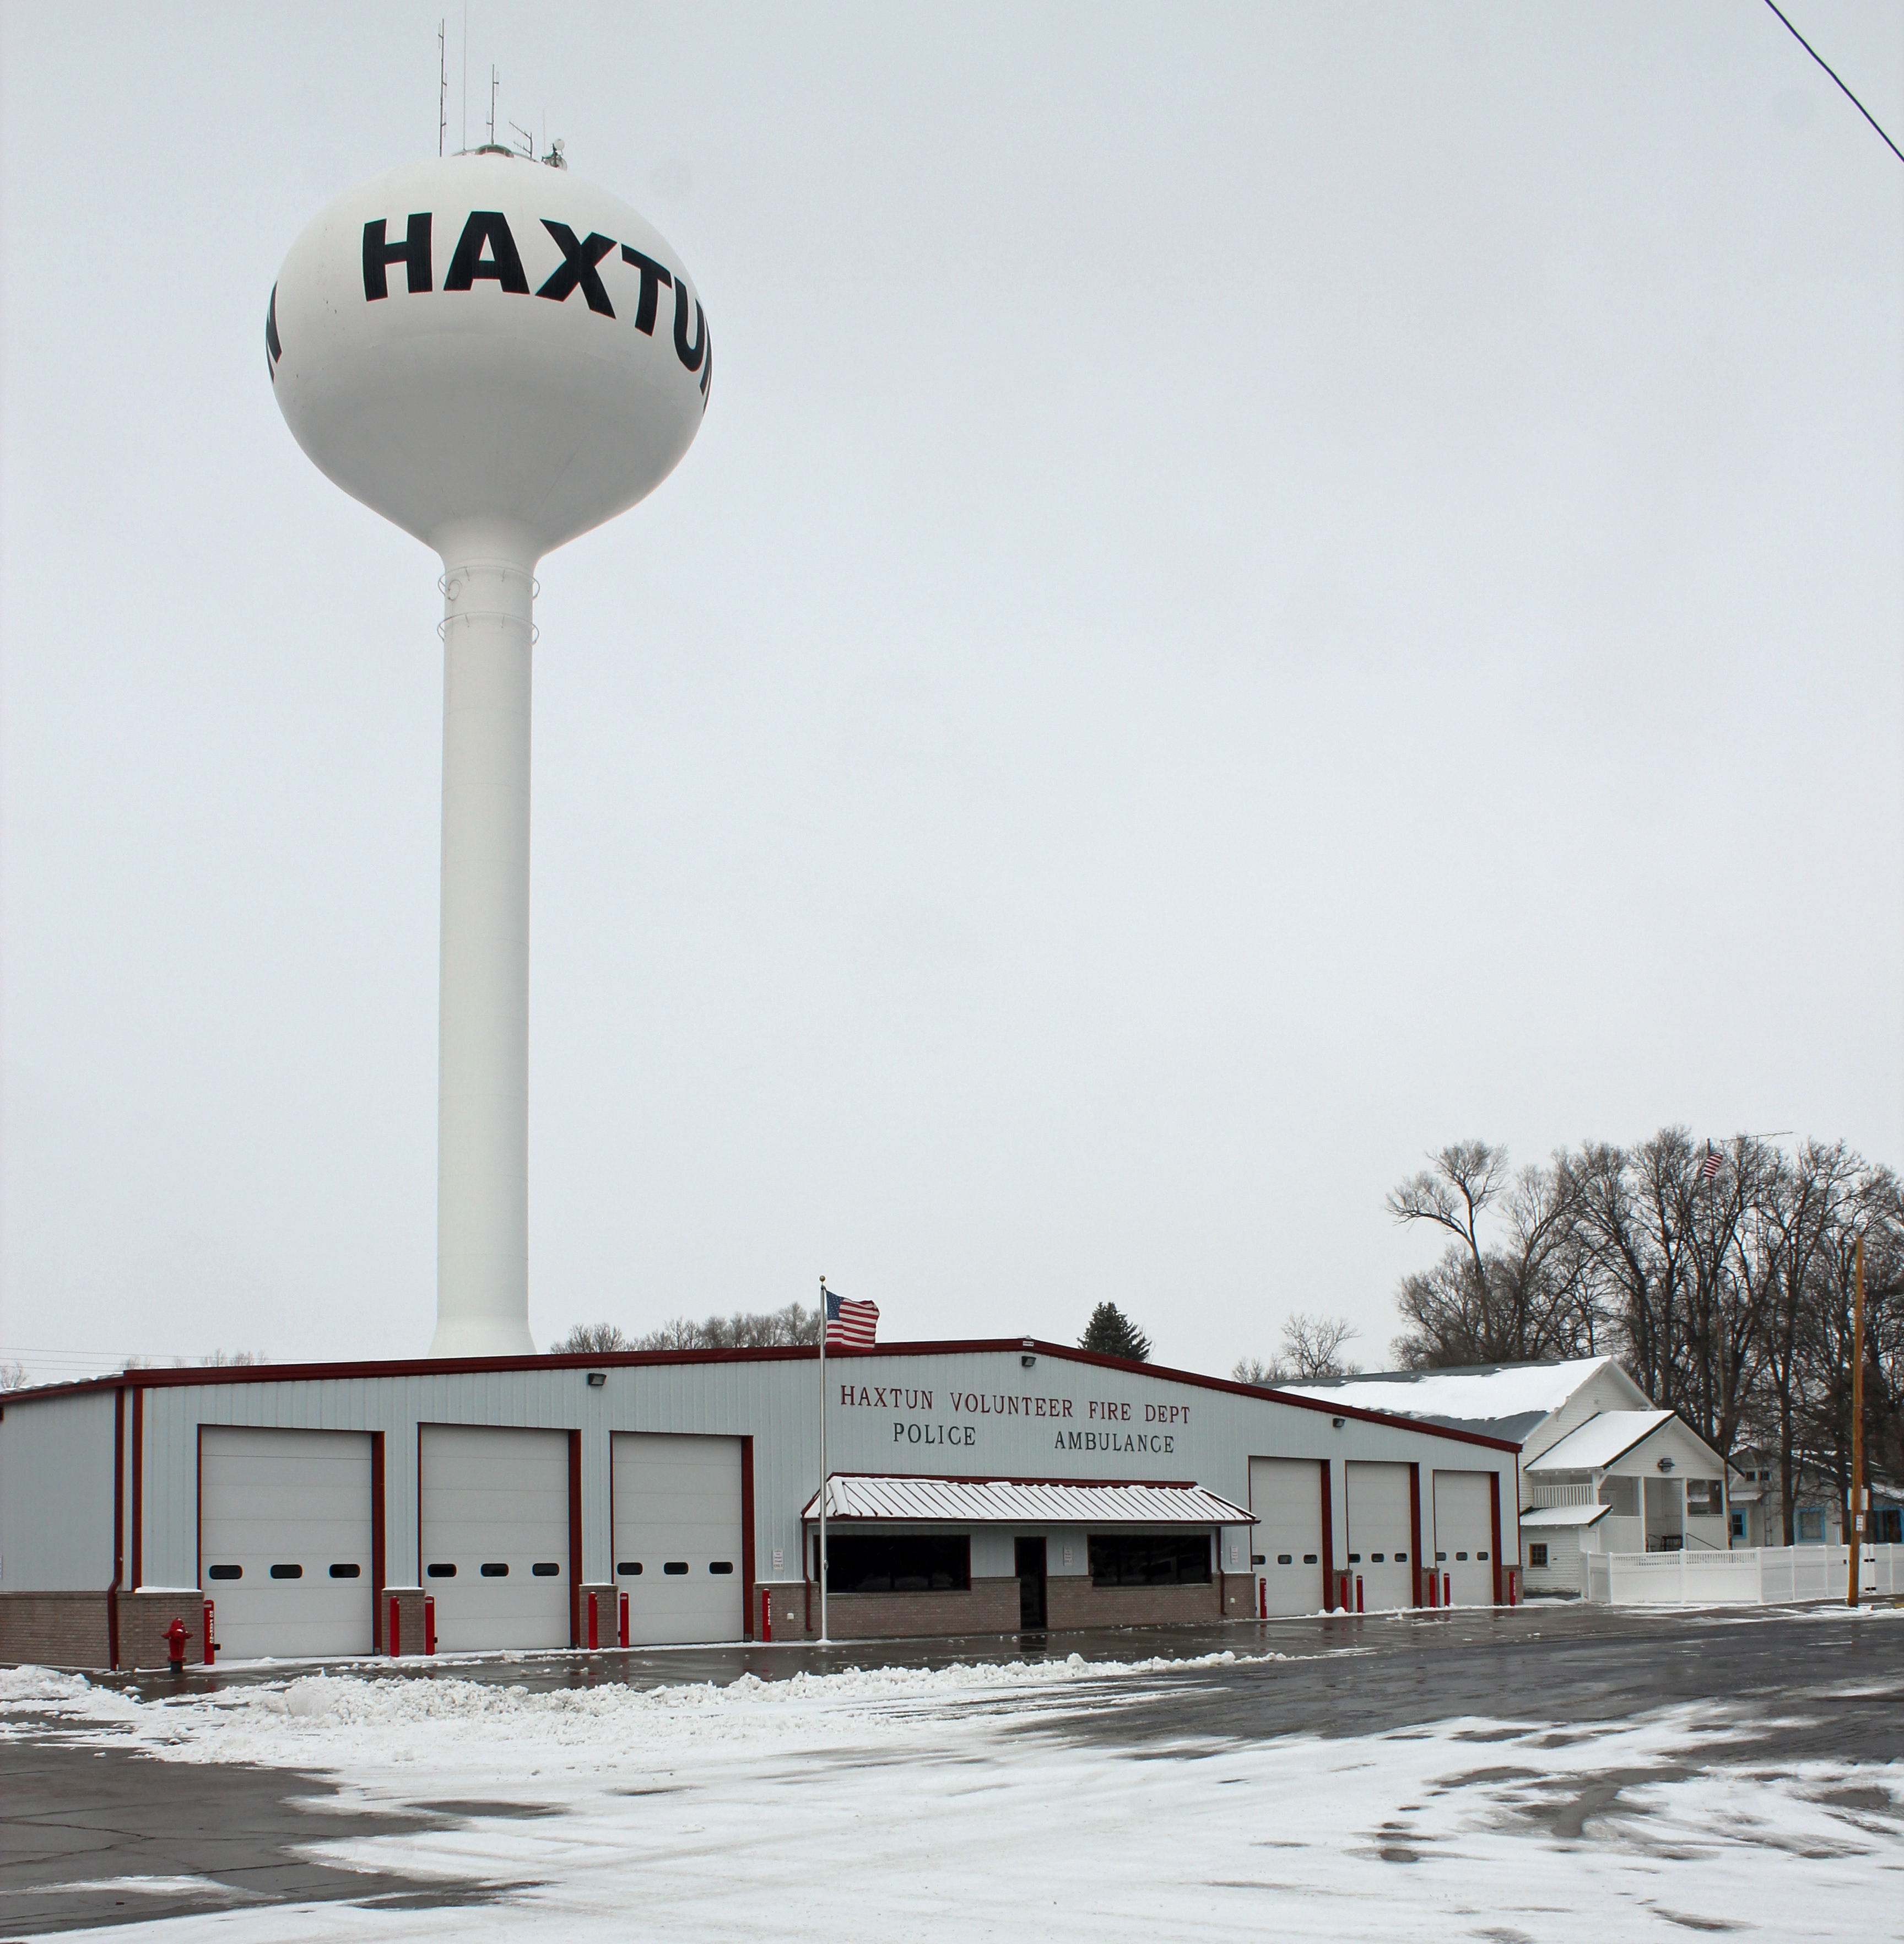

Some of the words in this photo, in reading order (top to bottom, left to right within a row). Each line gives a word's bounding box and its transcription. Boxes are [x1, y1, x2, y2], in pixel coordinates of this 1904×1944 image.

[840, 1385, 933, 1410] HAXTUN
[950, 1392, 1074, 1418] VOLUNTEER
[1089, 1401, 1132, 1421] FIRE
[1144, 1404, 1191, 1424] DEPT
[893, 1422, 976, 1446] POLICE
[1054, 1431, 1175, 1454] AMBULANCE
